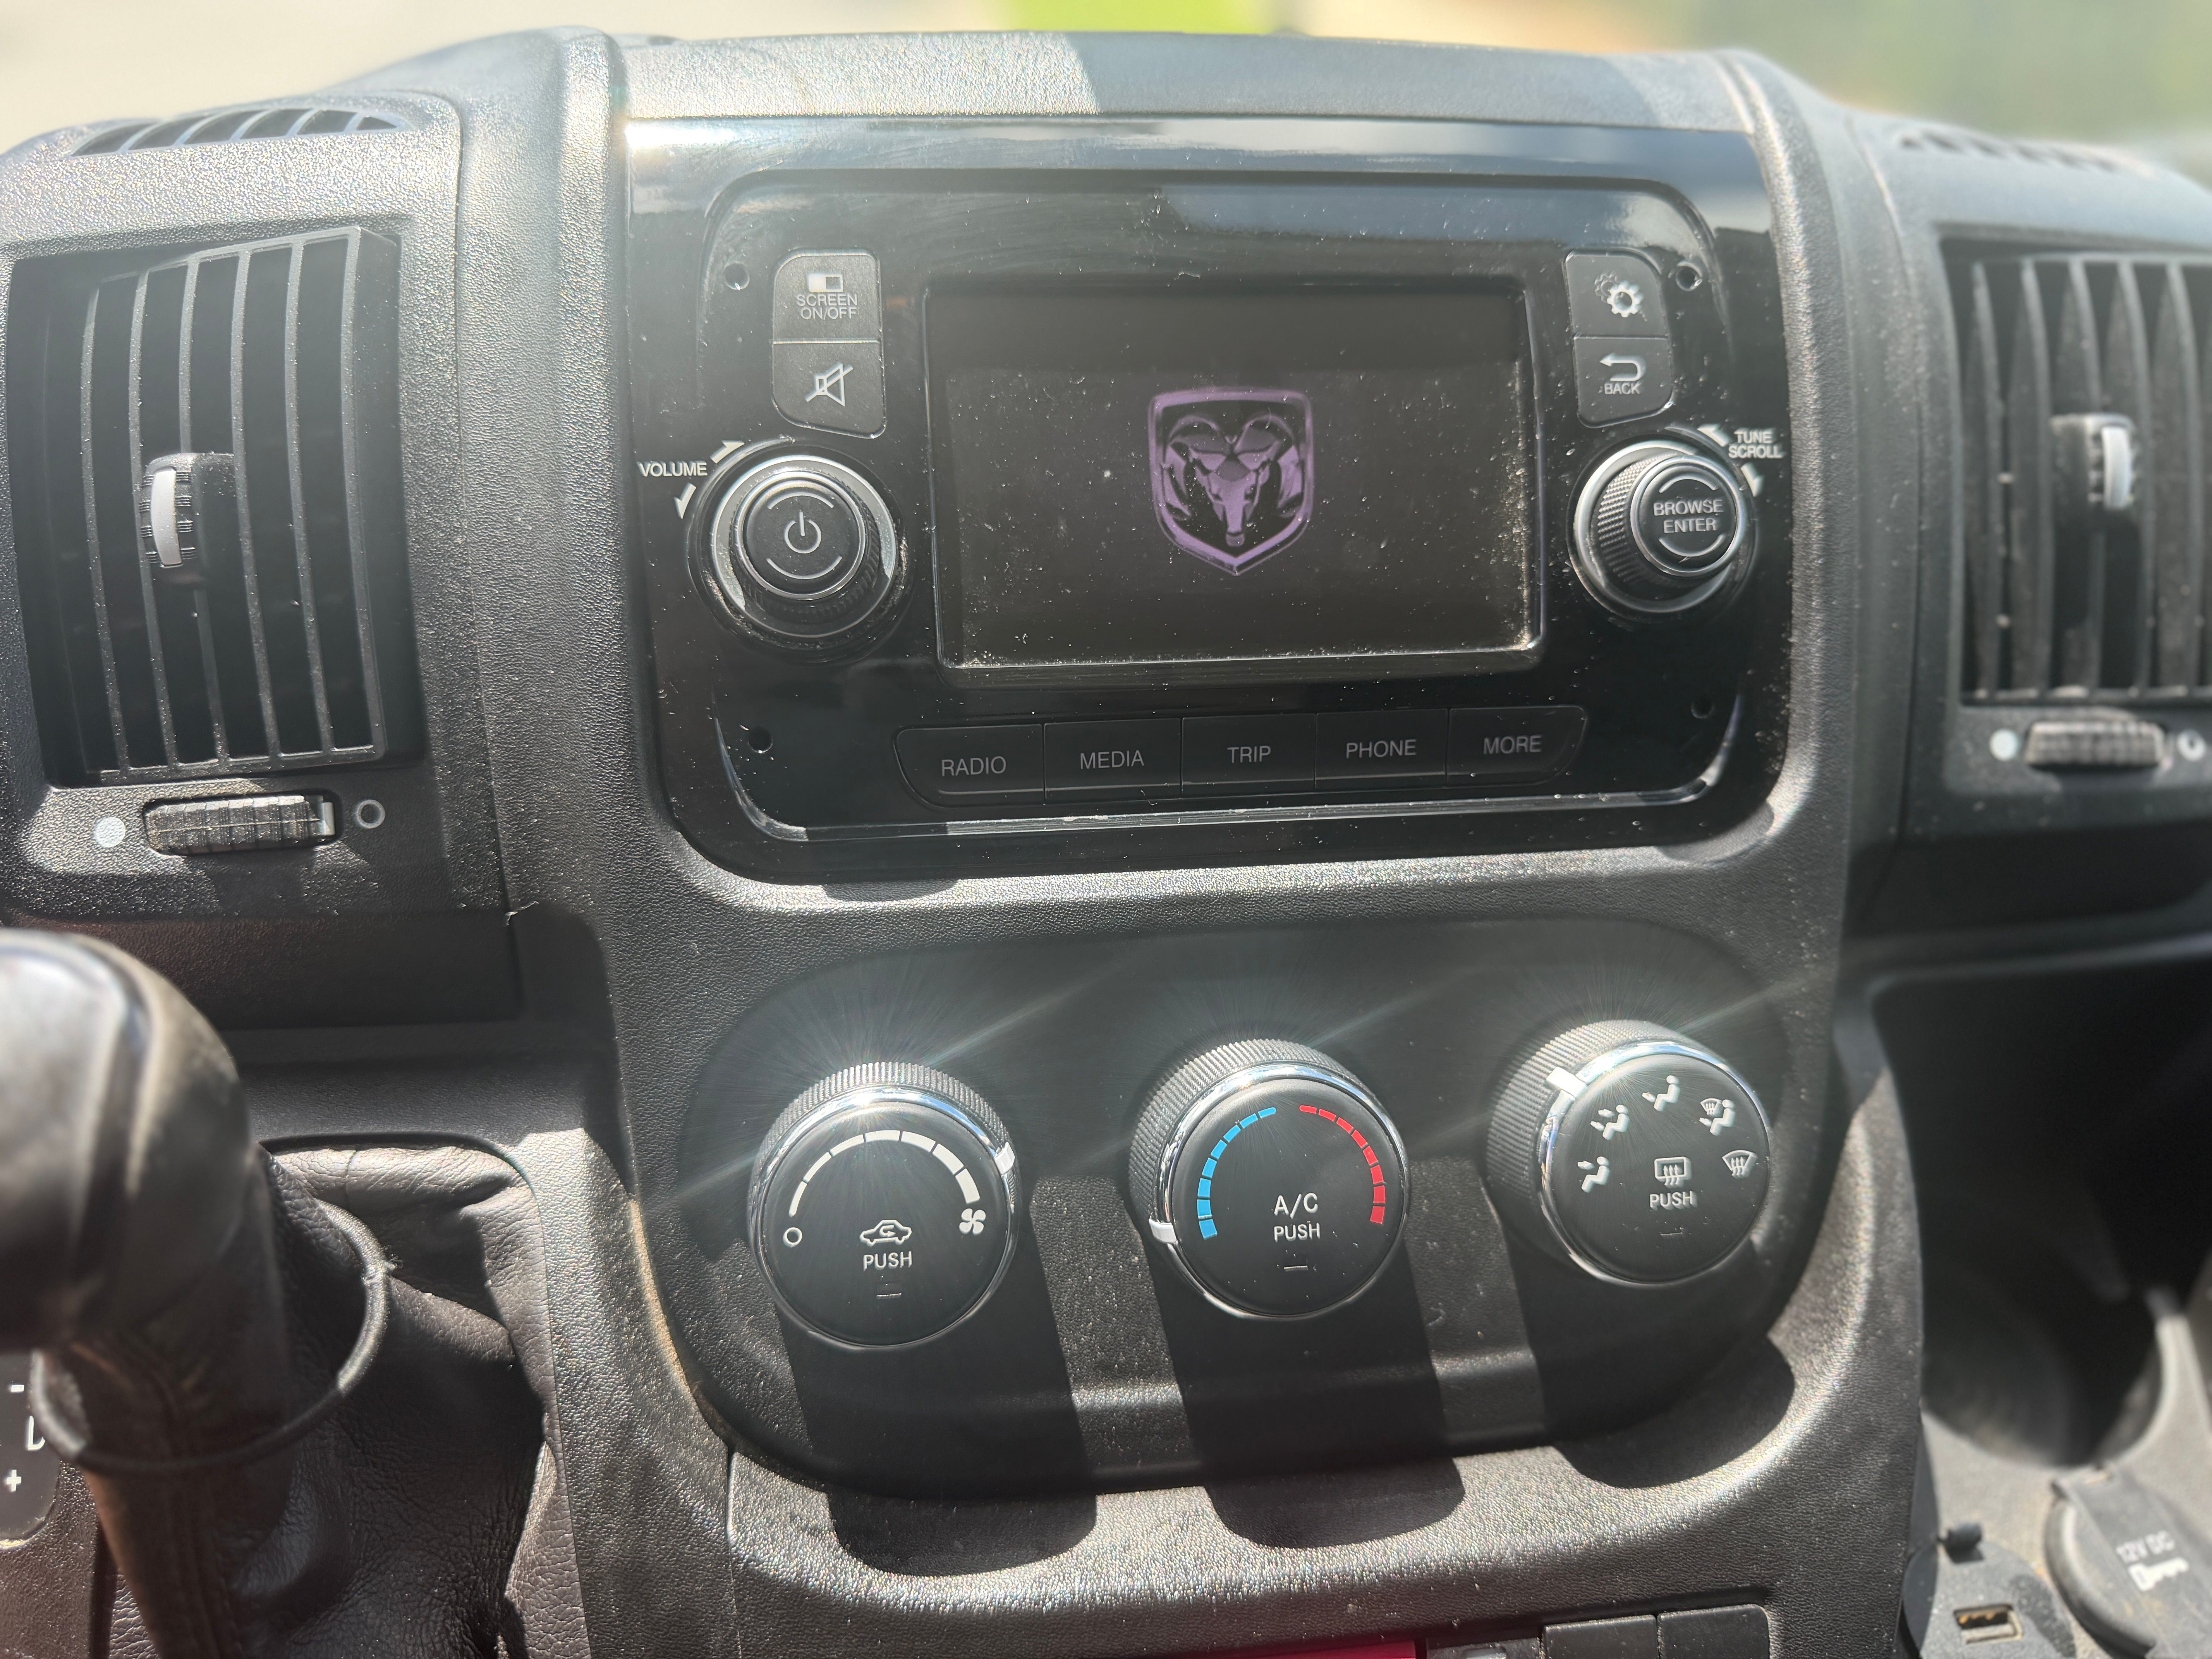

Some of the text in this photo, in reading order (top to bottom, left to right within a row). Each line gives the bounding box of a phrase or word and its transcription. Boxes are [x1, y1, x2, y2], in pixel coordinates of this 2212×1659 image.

[796, 293, 858, 307] SCREEN
[800, 306, 857, 320] ON/OFF
[1604, 383, 1640, 395] BACK
[1735, 429, 1774, 444] TUNE
[1729, 444, 1783, 459] SCROLL
[639, 461, 708, 477] VOLUME
[1653, 499, 1724, 516] BROWSE
[1663, 517, 1717, 534] ENTER
[1346, 739, 1417, 759] PHONE
[1483, 735, 1542, 754] MORE
[1079, 750, 1144, 769] MEDIA
[1227, 745, 1271, 763] TRIP
[941, 756, 1006, 777] RADIO
[1274, 1192, 1318, 1218] A/C
[1650, 1191, 1696, 1210] PUSH
[1274, 1223, 1321, 1242] PUSH
[863, 1251, 912, 1270] PUSH
